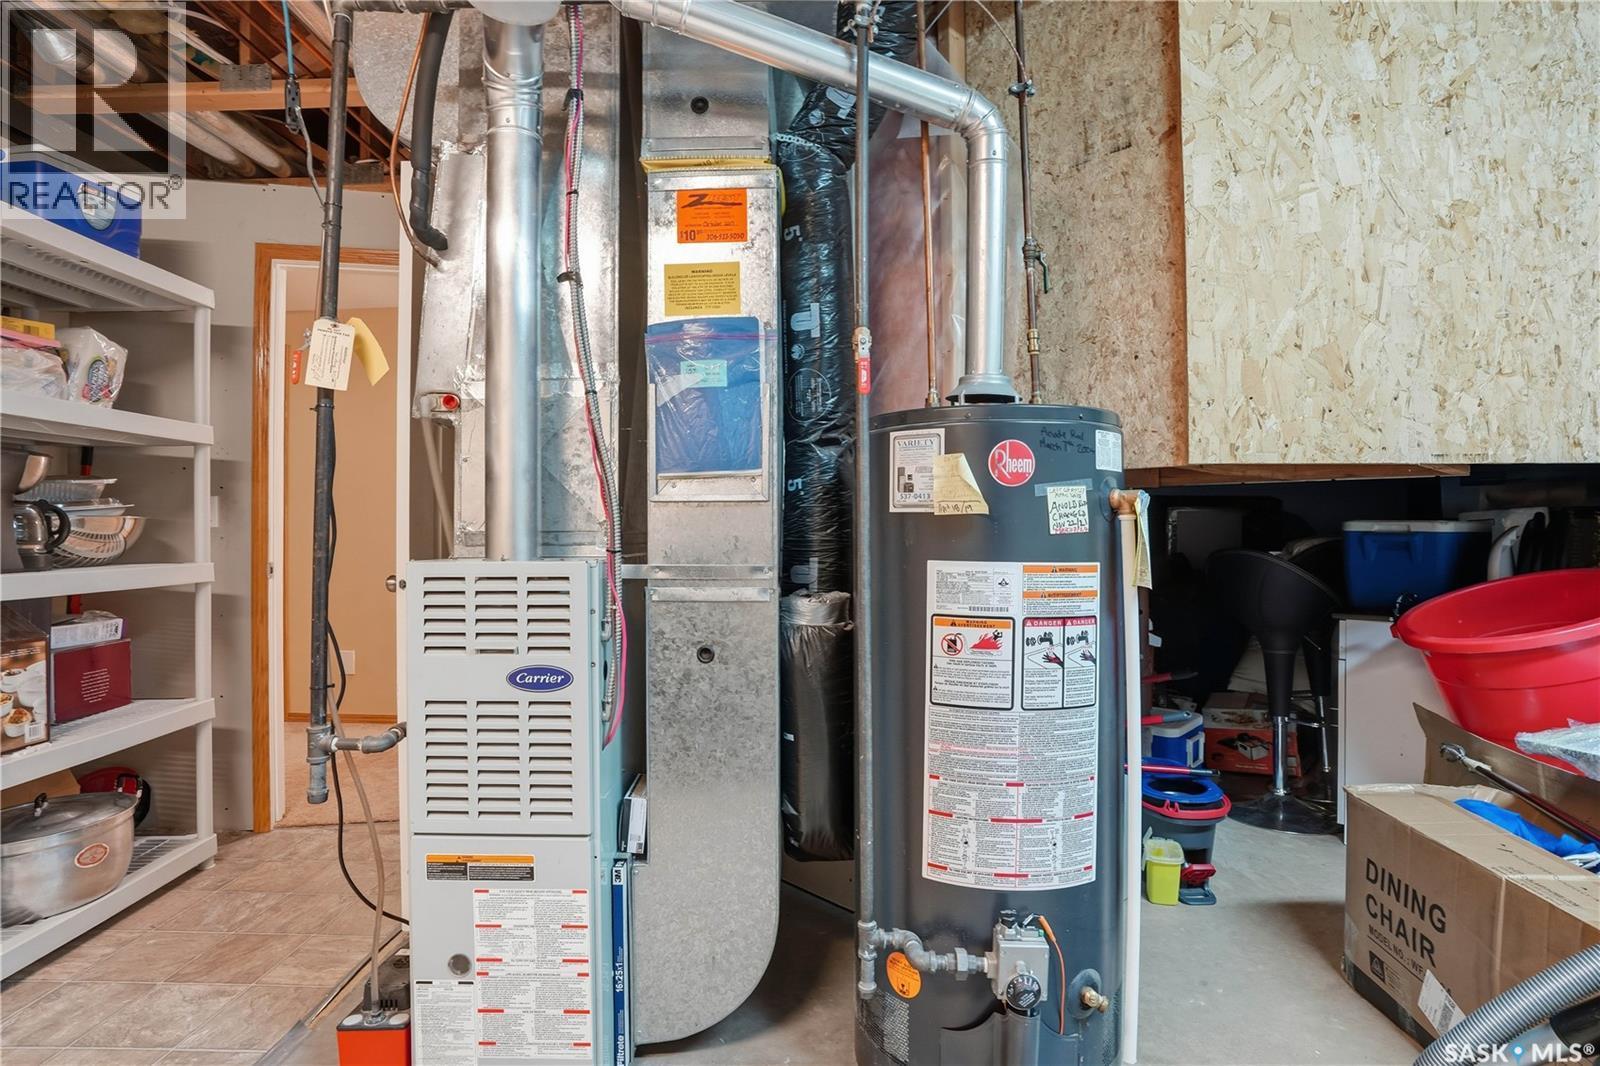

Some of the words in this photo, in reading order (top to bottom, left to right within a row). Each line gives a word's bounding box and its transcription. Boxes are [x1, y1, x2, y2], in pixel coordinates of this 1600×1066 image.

[897, 439, 935, 448] VARIETY
[995, 441, 1032, 479] Rheem
[516, 672, 564, 683] Carrier
[615, 869, 622, 883] 3M
[1366, 858, 1446, 933] DINING
[1366, 893, 1436, 968] CHAIR
[1368, 924, 1392, 951] MODEL
[616, 962, 624, 993] 16x25x1
